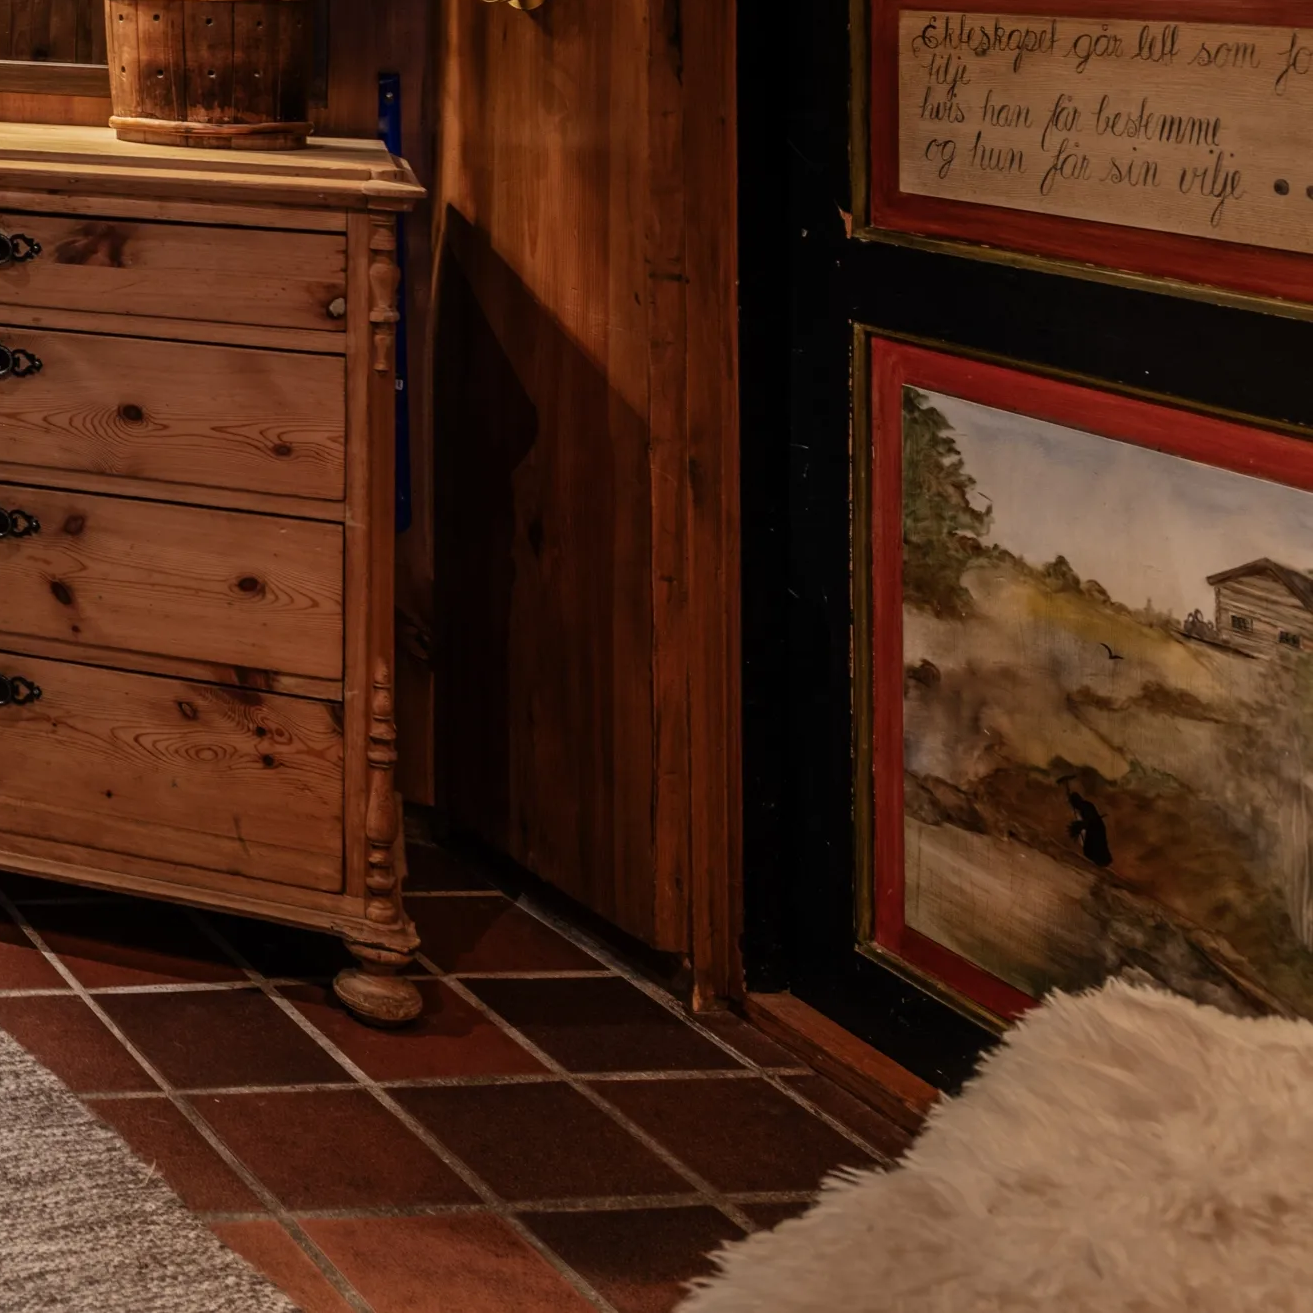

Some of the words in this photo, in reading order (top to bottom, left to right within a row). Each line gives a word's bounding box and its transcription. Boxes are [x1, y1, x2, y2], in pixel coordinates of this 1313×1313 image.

[1063, 23, 1123, 75] går
[1131, 24, 1181, 67] lett
[1187, 42, 1261, 69] som
[1274, 32, 1313, 97] fo
[919, 86, 966, 124] hvis
[980, 89, 1035, 129] han
[1041, 93, 1083, 152] får
[1091, 94, 1222, 147] bestemme
[924, 138, 957, 180] og
[970, 130, 1027, 174] hun
[1039, 138, 1092, 197] får
[1098, 147, 1161, 188] sin
[1179, 149, 1248, 228] vilje
